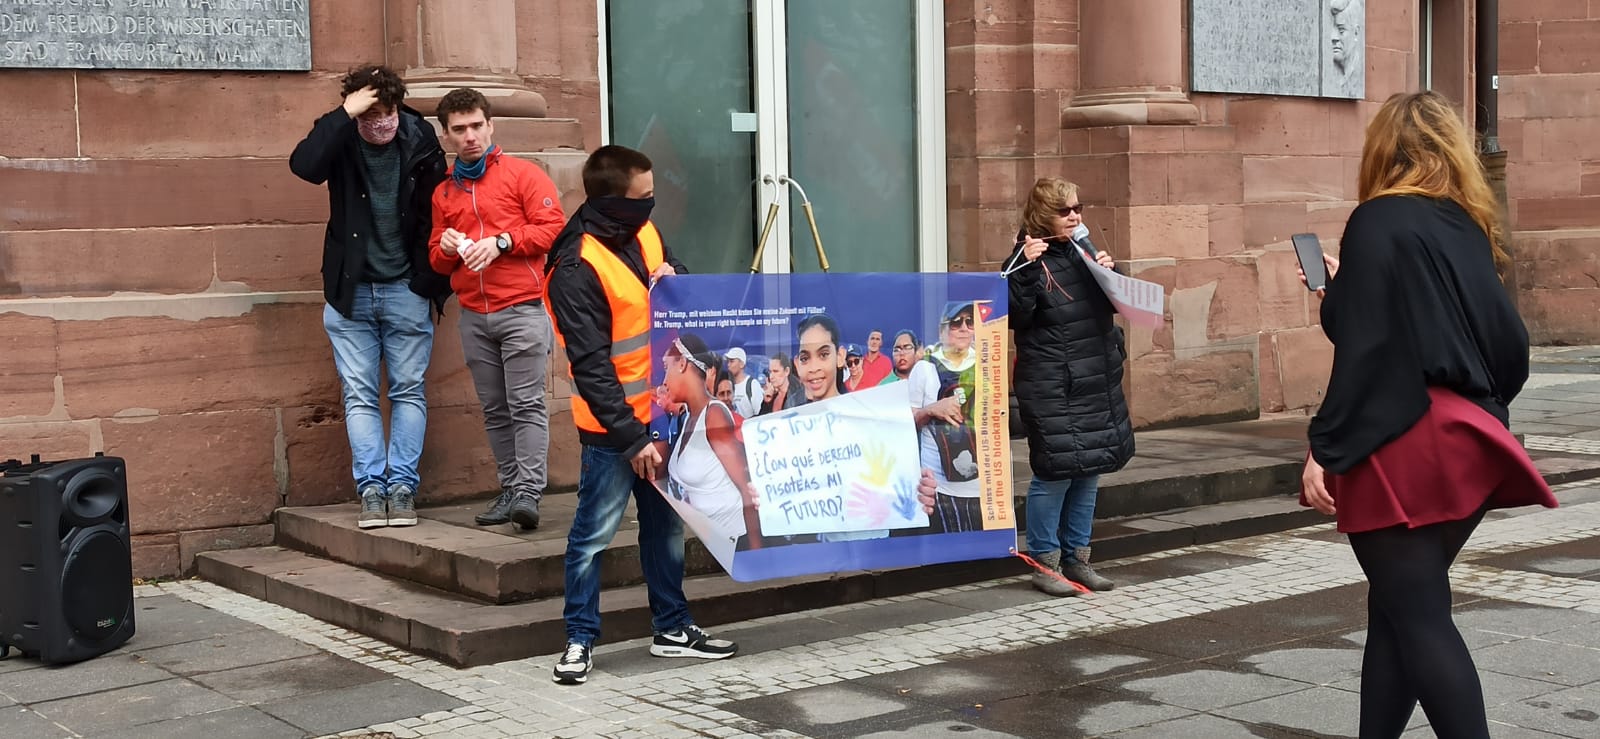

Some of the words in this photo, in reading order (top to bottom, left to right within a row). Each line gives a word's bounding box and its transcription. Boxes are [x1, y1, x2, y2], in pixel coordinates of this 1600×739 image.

[2, 13, 40, 32] DEM
[47, 14, 118, 34] FREUND
[126, 16, 159, 35] DER
[162, 17, 306, 37] WISSENSCHAFTEN
[4, 41, 57, 60] STADT
[66, 41, 168, 62] FRANKFURT
[173, 45, 206, 62] AM
[214, 47, 262, 63] MAIN
[654, 310, 668, 318] Herr
[668, 310, 688, 319] Trump,
[688, 310, 698, 318] mit
[753, 307, 762, 315] Sie
[684, 319, 697, 328] what
[698, 319, 704, 327] is
[704, 320, 716, 328] your
[717, 319, 729, 328] right
[980, 338, 989, 364] Kuba!
[991, 330, 1001, 362] Cuba!
[981, 366, 989, 393] gegen
[991, 365, 1002, 405] against
[756, 421, 777, 445] Sr
[980, 395, 990, 452] US-Blockade
[991, 408, 1001, 457] blockade
[819, 442, 862, 466] DERECHO
[982, 453, 991, 468] der
[983, 470, 992, 485] mit
[993, 461, 1003, 477] US
[995, 480, 1004, 497] the
[778, 495, 845, 526] FUTURO?
[984, 487, 995, 521] Schluss
[995, 500, 1007, 520] End
